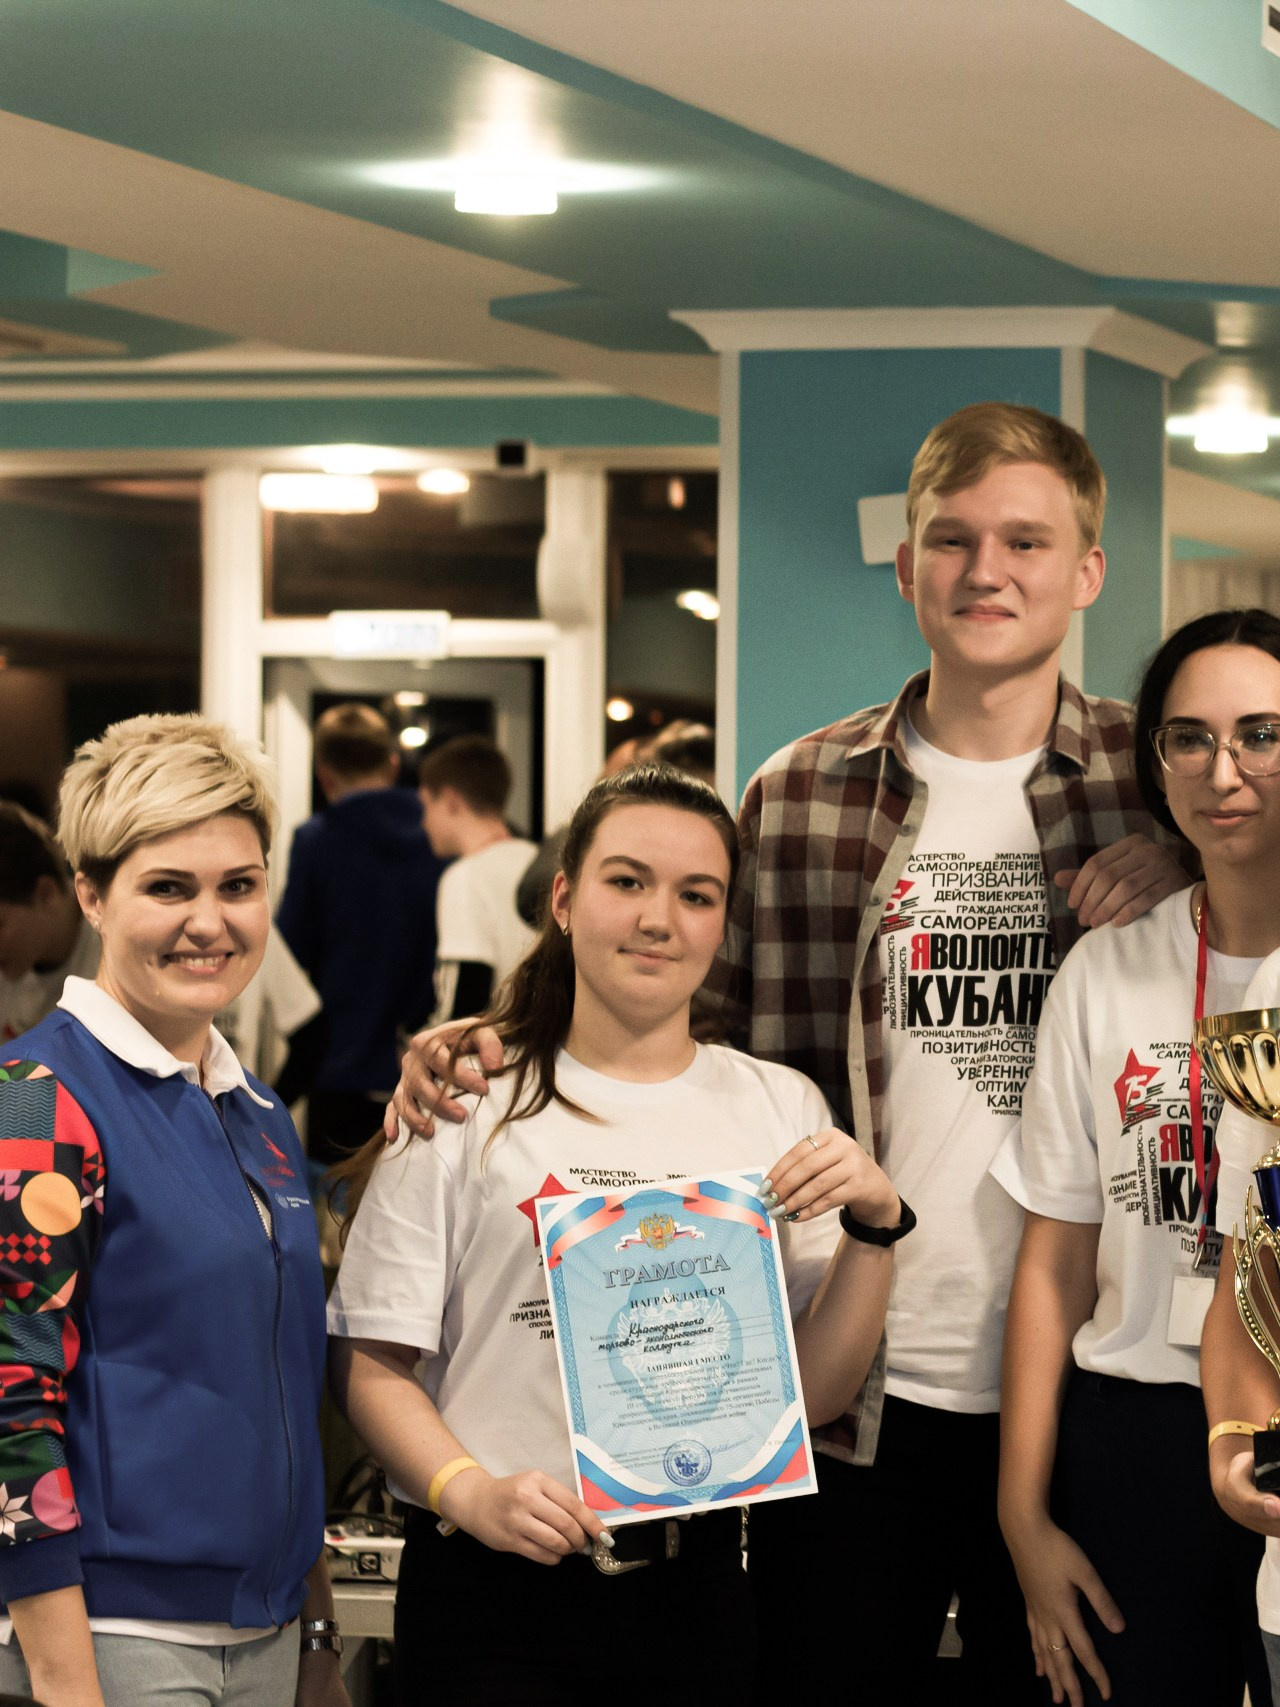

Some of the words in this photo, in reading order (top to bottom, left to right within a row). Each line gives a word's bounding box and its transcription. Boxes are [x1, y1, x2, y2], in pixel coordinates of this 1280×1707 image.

[908, 861, 1041, 873] САМООПРЕДЕЛЕНИЕ
[934, 889, 1003, 902] ДЕЙСТВИЕ
[956, 903, 1039, 915] ГРАЖДАНСКАЯ
[569, 1168, 636, 1178] МАСТЕРСТВО
[603, 1253, 731, 1288] ГРАМОТА
[630, 1286, 726, 1309] НАГРАЖДАЕТСЯ
